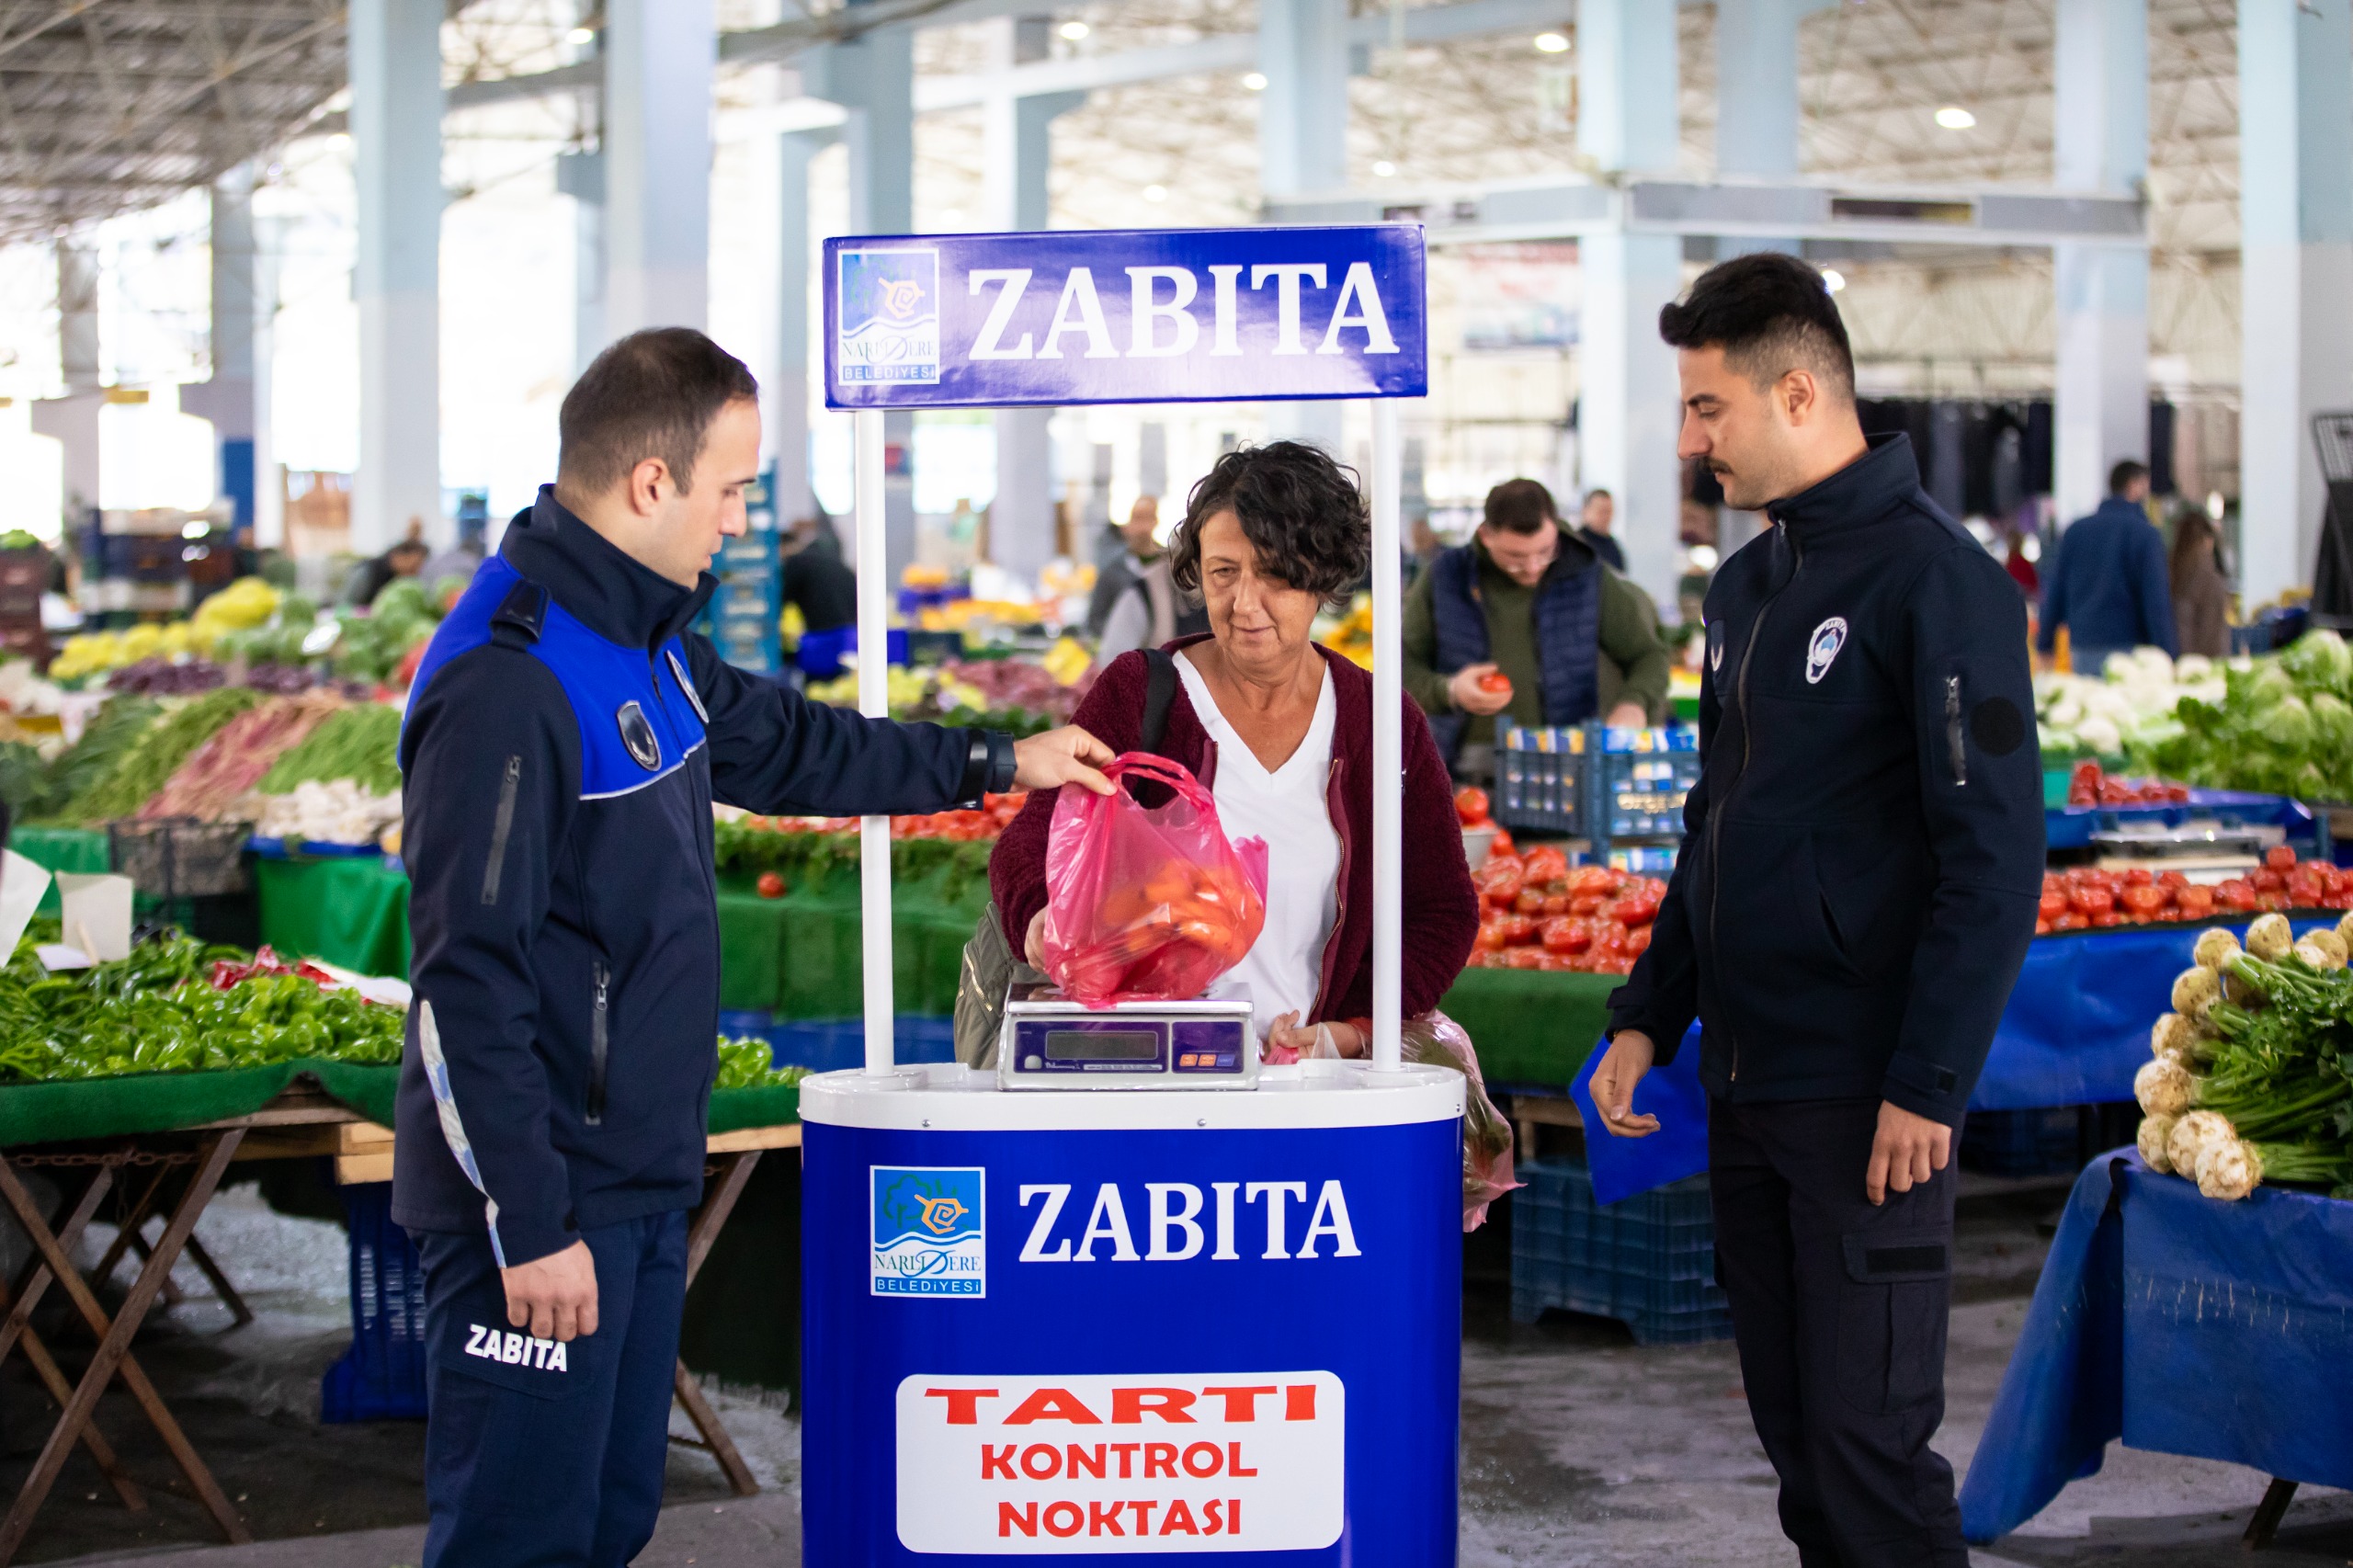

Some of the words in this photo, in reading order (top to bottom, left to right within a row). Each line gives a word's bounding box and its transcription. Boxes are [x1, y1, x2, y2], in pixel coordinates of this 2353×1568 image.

[969, 262, 1400, 360] ZABITA
[1018, 1180, 1361, 1262] ZABITA
[464, 1324, 567, 1372] ZABITA
[925, 1385, 1316, 1425] TARTI
[982, 1441, 1258, 1480] KONTROL
[998, 1499, 1241, 1538] NOKTASI
